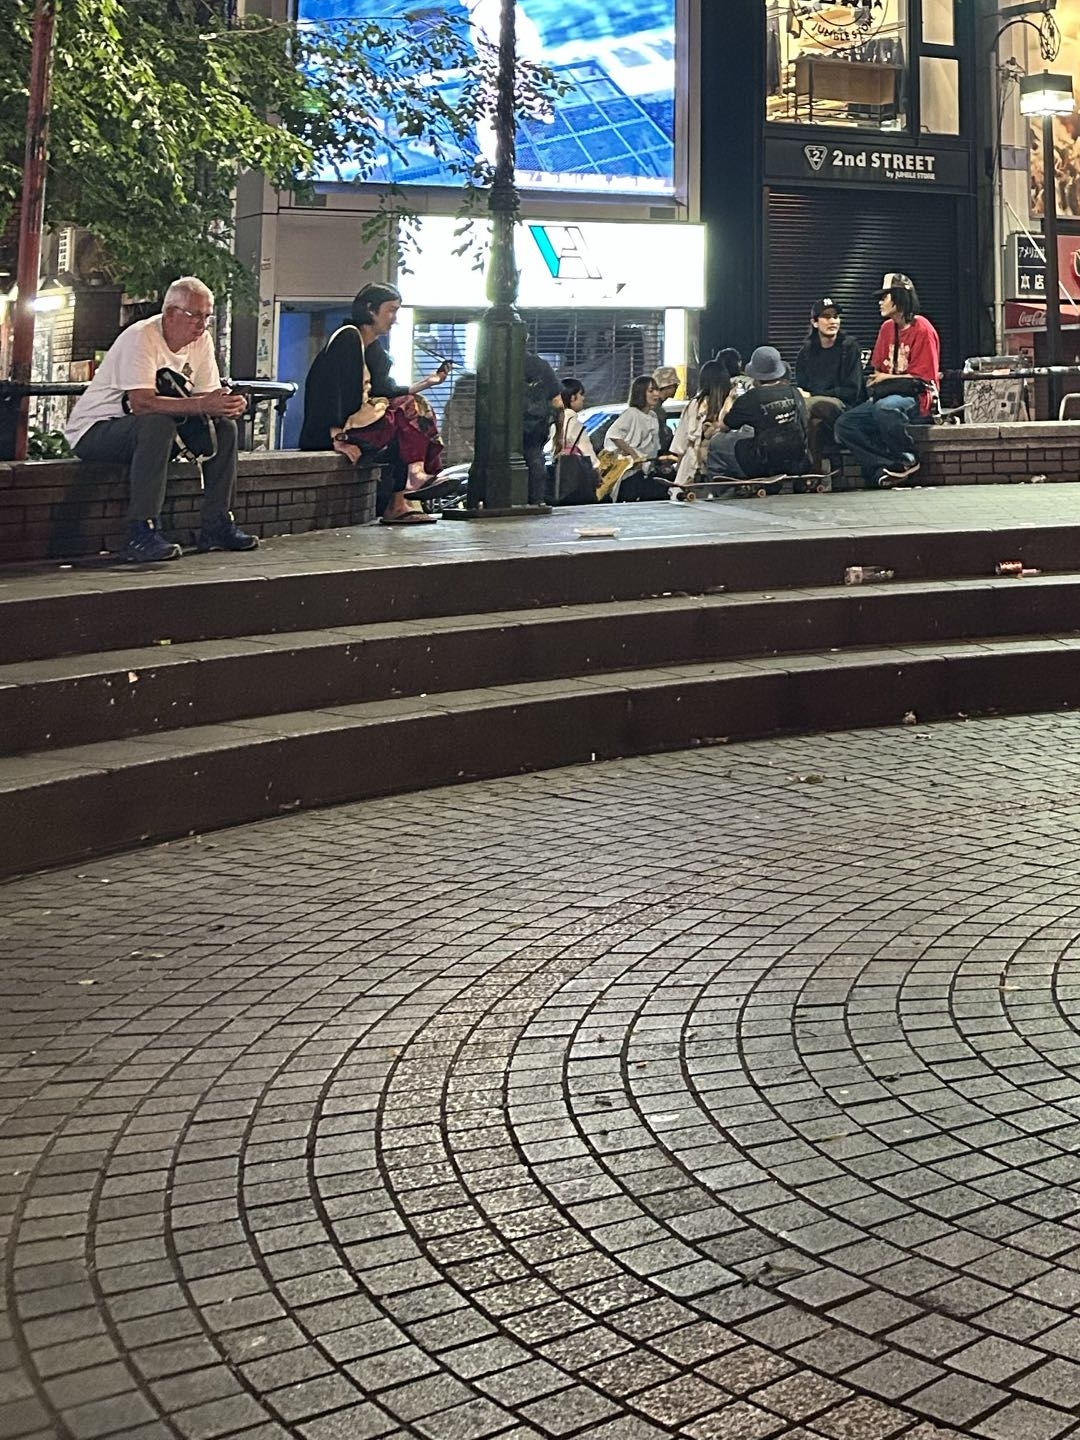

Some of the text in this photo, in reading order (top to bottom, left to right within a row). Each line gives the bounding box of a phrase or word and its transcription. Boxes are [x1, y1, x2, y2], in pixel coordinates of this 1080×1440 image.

[832, 149, 866, 167] 2nd
[871, 152, 936, 171] STREET
[1020, 273, 1046, 290] 本店
